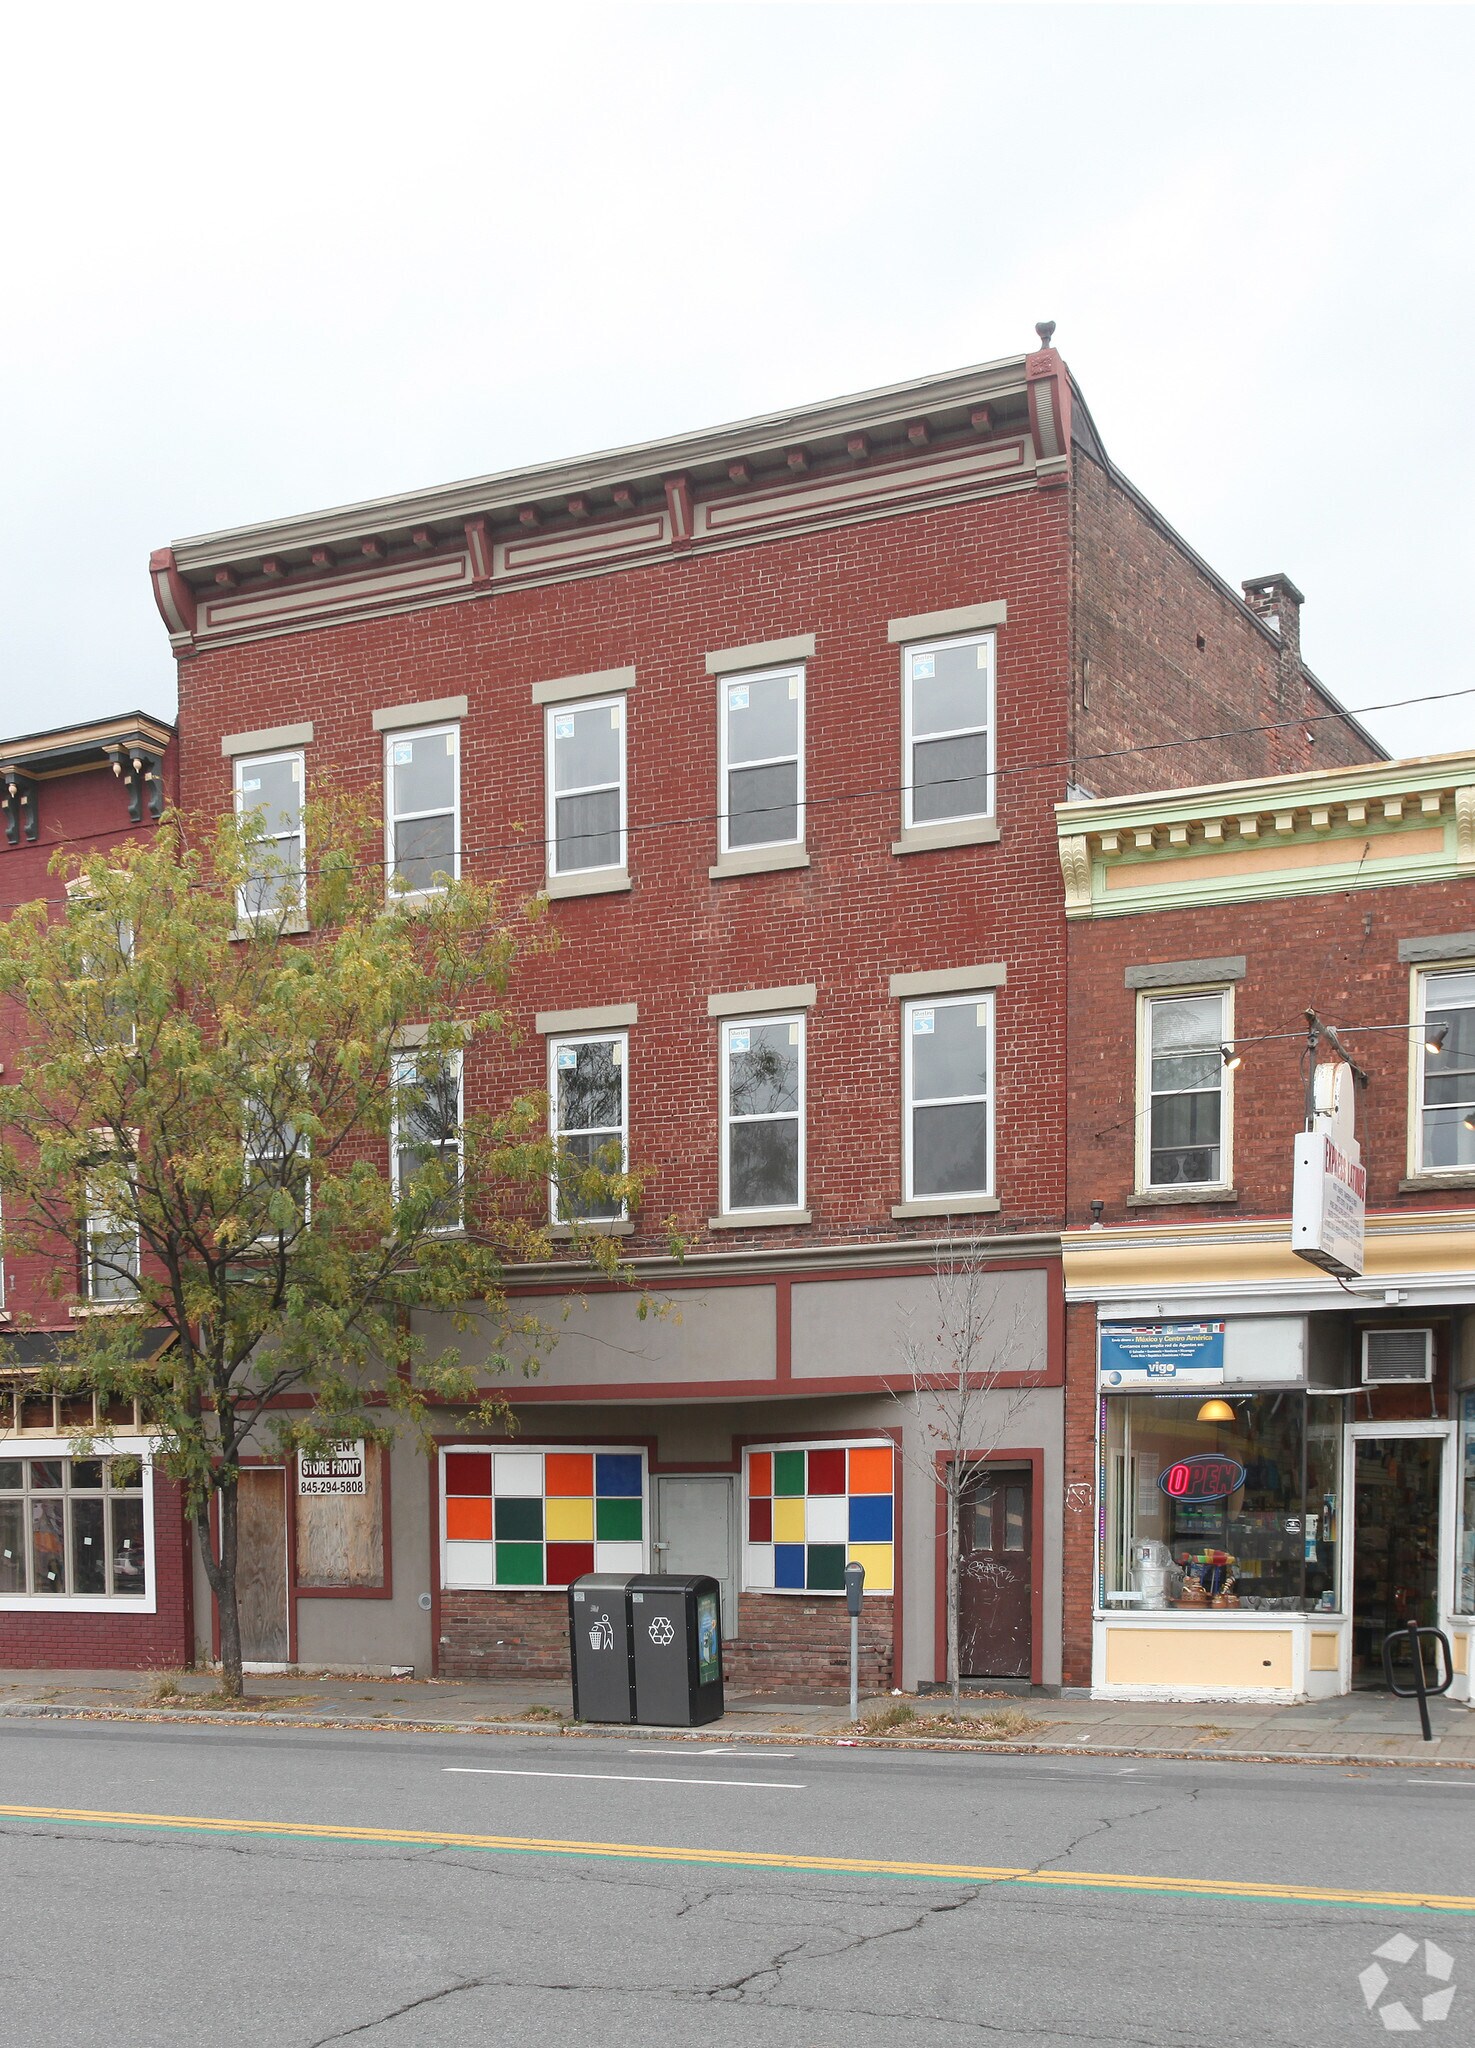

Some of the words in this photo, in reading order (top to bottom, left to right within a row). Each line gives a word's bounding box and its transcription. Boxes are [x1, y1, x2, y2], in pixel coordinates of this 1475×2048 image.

[1148, 1361, 1174, 1373] vigo
[303, 1460, 330, 1475] STORE
[332, 1459, 360, 1475] FRONT
[1168, 1464, 1236, 1495] OPEN
[301, 1481, 363, 1493] 845-294-5808
